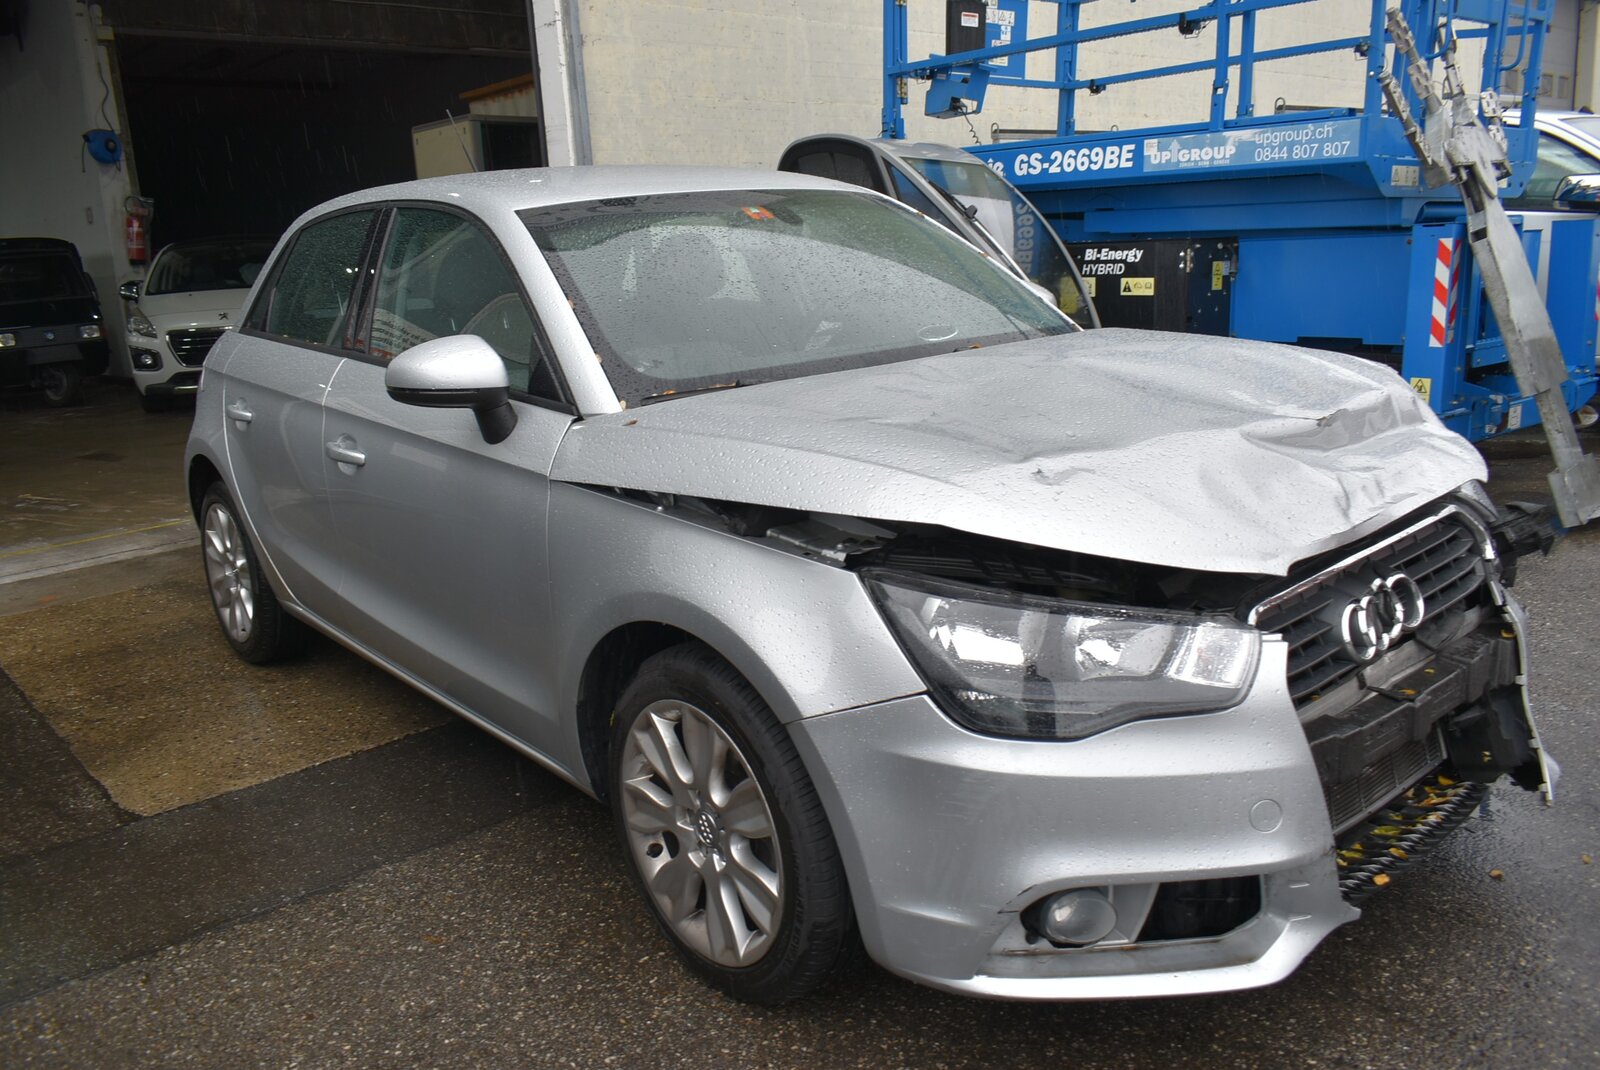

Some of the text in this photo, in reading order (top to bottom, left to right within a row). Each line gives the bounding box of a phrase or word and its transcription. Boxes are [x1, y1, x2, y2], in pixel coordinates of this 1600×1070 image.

[1255, 124, 1333, 146] upgroup.ch
[1014, 144, 1136, 177] GS-2669BE
[1178, 145, 1236, 162] GROUP
[1255, 141, 1351, 162] 0844 807 807
[1084, 248, 1144, 263] Bi-Energy
[1082, 263, 1125, 275] HYBRID
